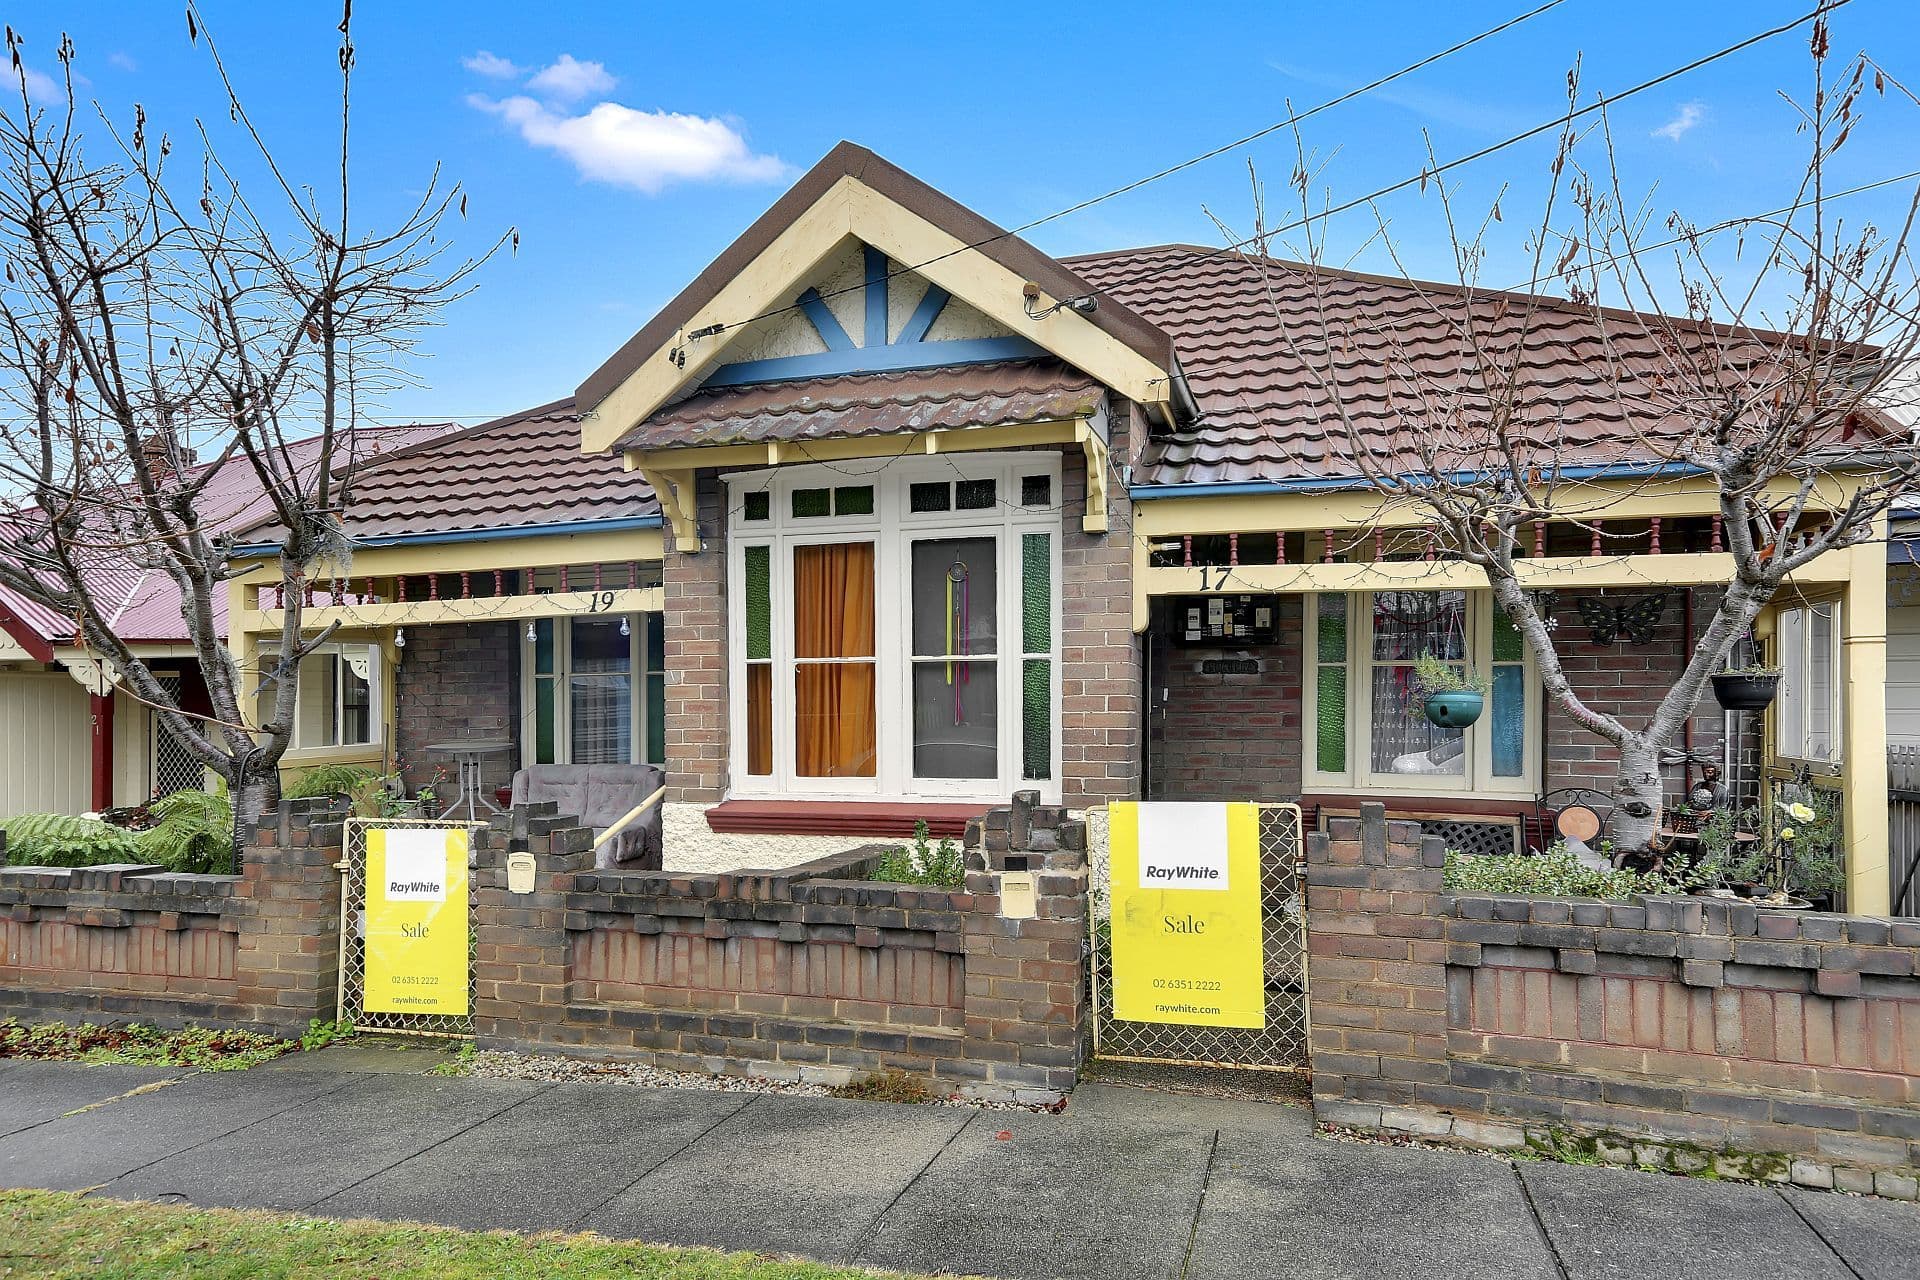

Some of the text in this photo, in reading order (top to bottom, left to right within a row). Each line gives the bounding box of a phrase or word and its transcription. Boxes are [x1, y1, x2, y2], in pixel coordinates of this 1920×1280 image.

[1199, 566, 1233, 592] 17
[589, 591, 615, 613] 19
[1146, 865, 1219, 880] RayWhite
[390, 881, 440, 894] RayWhite
[401, 922, 429, 938] Sale
[1164, 914, 1205, 934] Sale
[391, 975, 439, 985] 02 6351 2222
[1152, 978, 1221, 991] 02 6351 2222
[392, 995, 438, 1005] raywhite.com
[1155, 1003, 1220, 1015] raywhite.com
